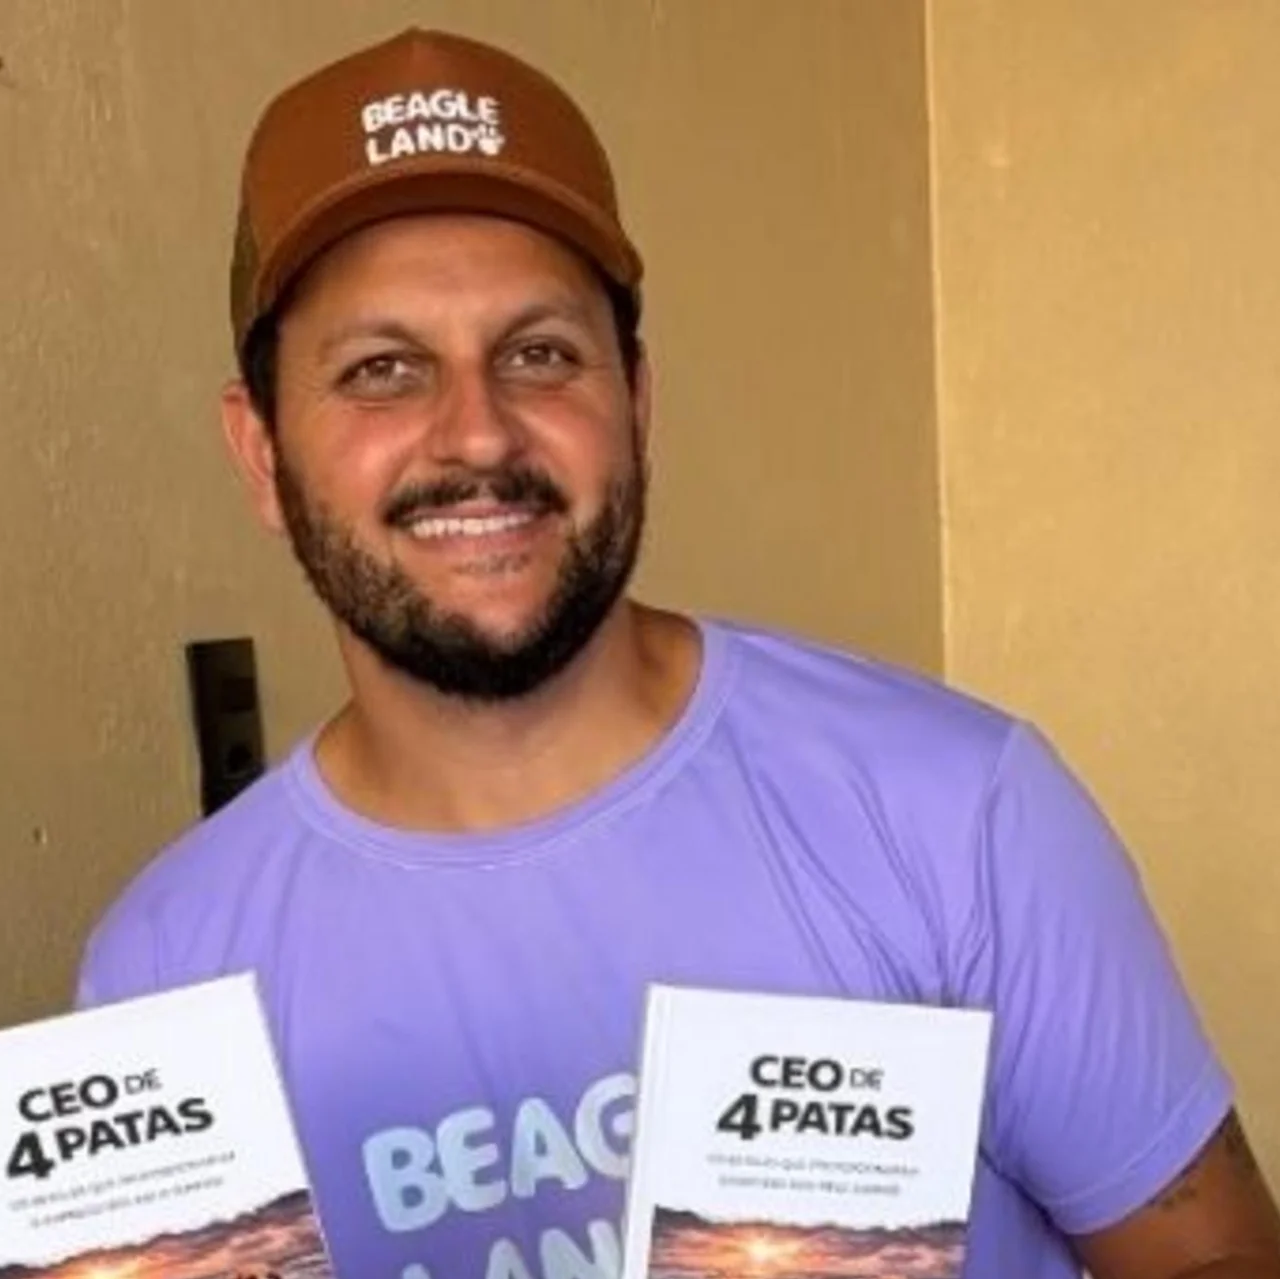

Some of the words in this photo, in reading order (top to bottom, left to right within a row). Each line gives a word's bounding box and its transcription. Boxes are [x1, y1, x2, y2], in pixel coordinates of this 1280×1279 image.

[361, 89, 502, 133] BEAGLE
[365, 123, 471, 165] LAND
[18, 1074, 119, 1123] CEO
[123, 1067, 163, 1096] DE
[749, 1055, 844, 1092] CEO
[849, 1066, 885, 1091] DE
[6, 1130, 56, 1180] 4
[55, 1097, 215, 1162] PATAS
[716, 1093, 763, 1141] 4
[769, 1098, 915, 1141] PATAS
